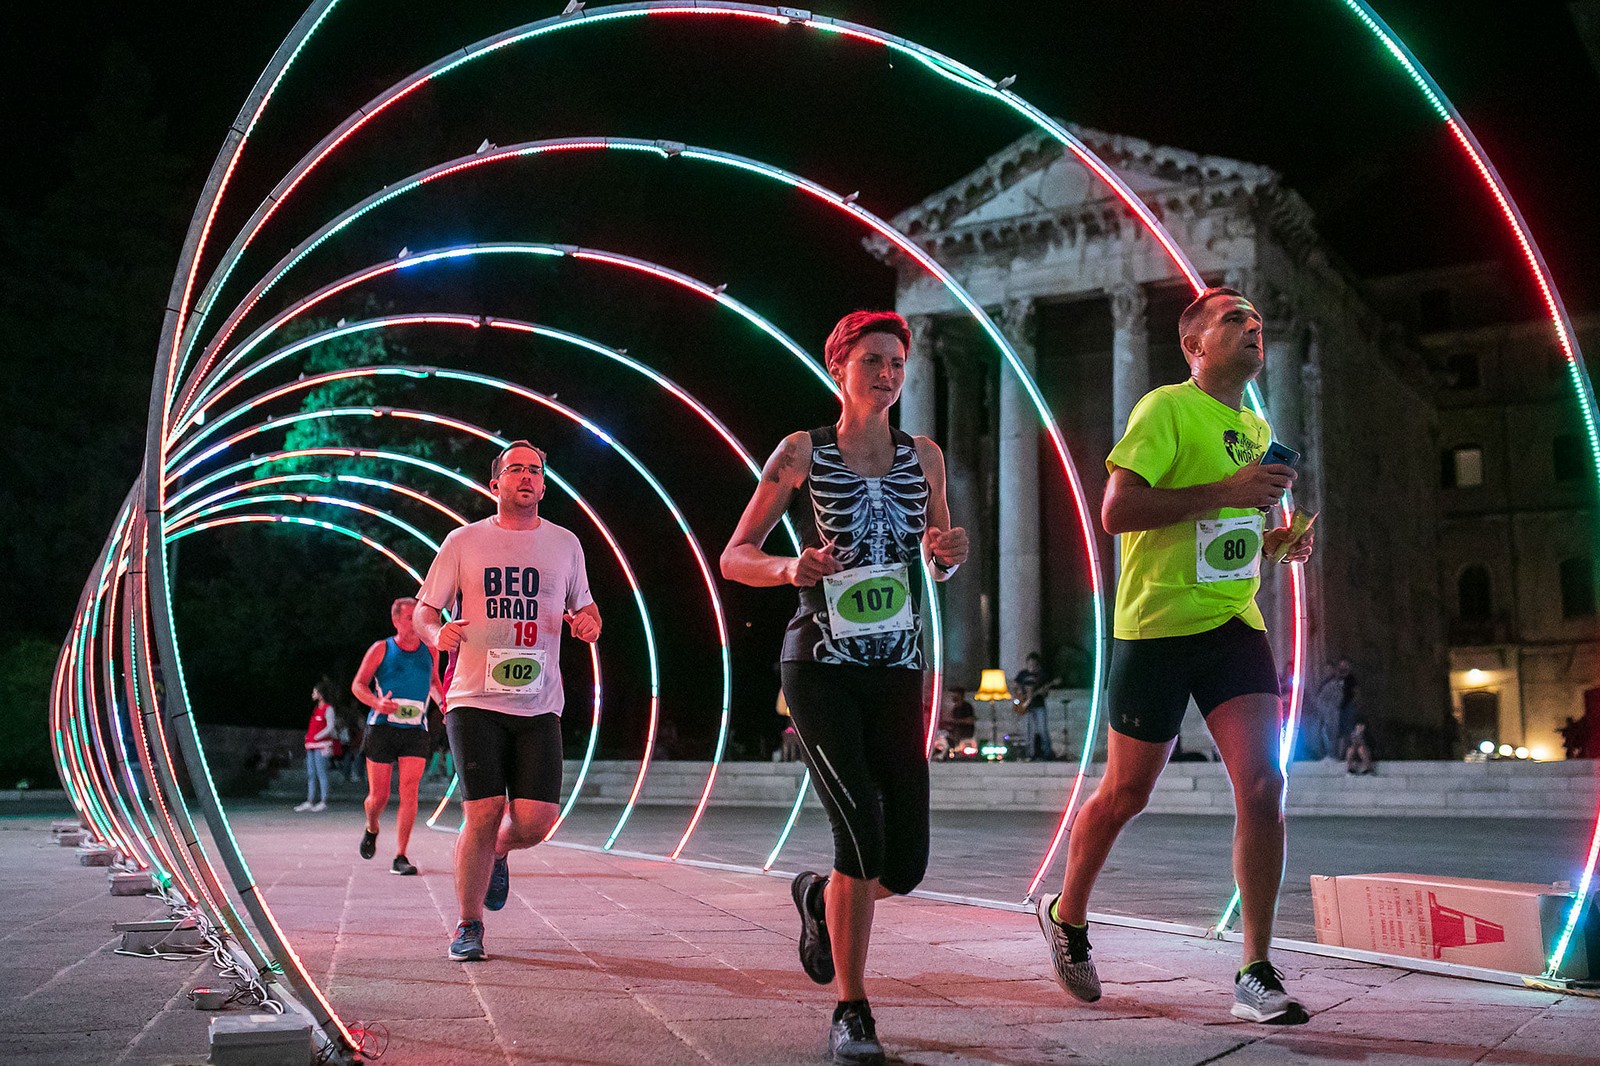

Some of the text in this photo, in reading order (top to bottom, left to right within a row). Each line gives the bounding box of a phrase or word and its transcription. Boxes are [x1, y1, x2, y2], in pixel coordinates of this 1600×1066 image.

[1224, 538, 1246, 560] 80
[484, 567, 540, 597] BEO
[486, 597, 538, 620] GRAD
[851, 587, 894, 612] 107
[513, 621, 538, 647] 19
[503, 664, 533, 679] 102
